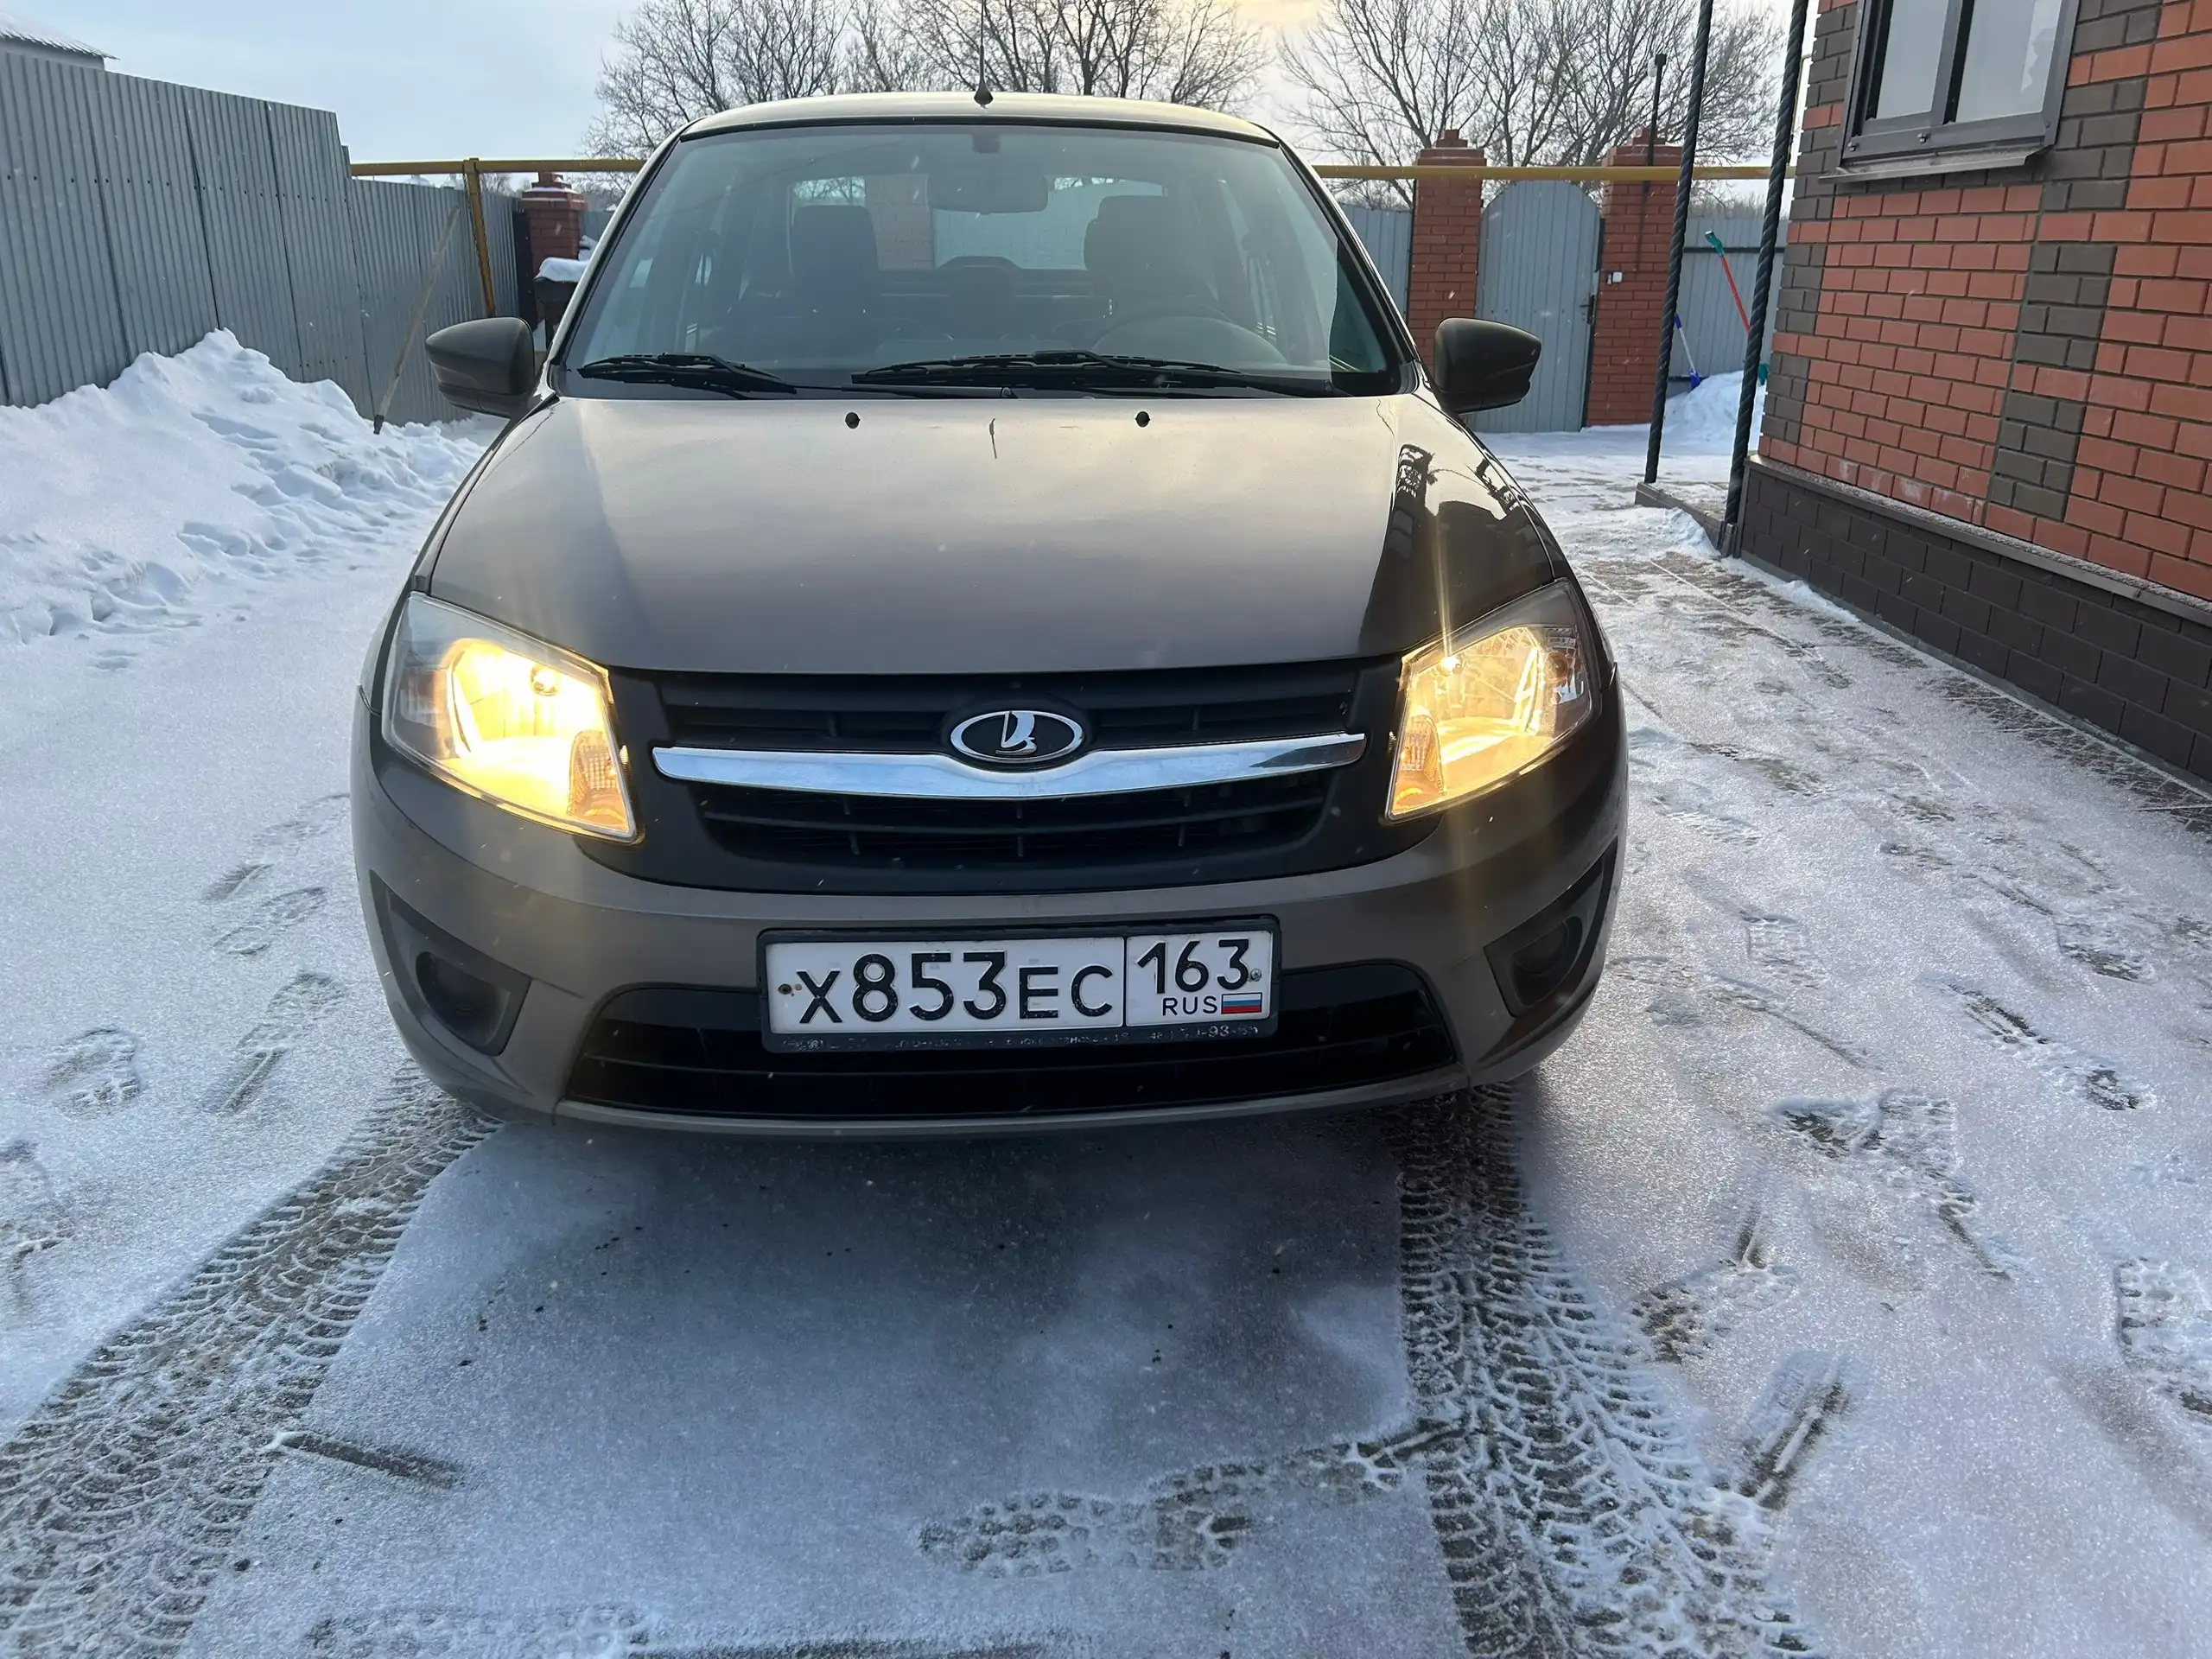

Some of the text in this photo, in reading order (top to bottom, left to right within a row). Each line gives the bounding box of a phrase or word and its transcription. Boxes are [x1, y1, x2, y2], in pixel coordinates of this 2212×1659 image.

[796, 938, 1249, 1024] Х853ЕС 163
[1162, 995, 1218, 1017] RUS
